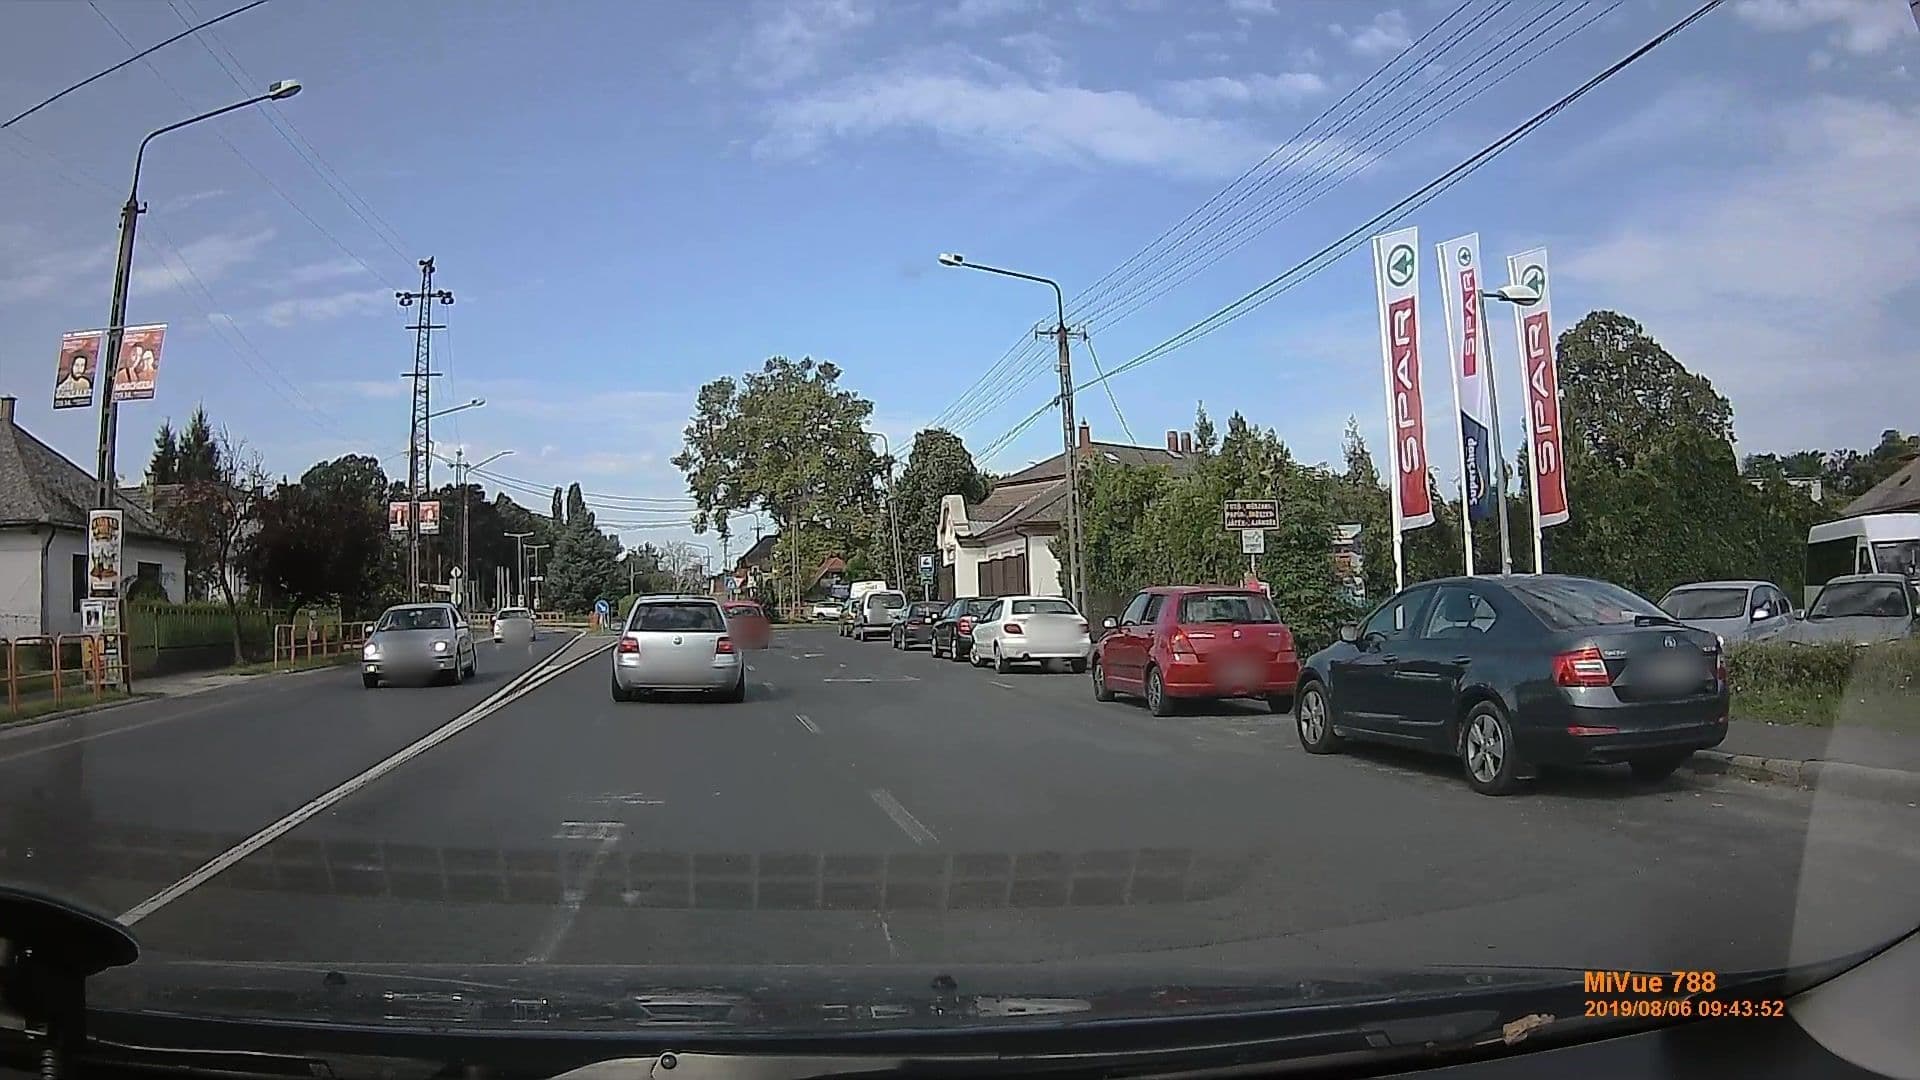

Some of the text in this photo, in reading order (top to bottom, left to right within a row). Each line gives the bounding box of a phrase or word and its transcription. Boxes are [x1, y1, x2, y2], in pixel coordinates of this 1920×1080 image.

[1394, 305, 1420, 475] SPAR
[1462, 271, 1476, 357] SPAR
[1528, 321, 1556, 475] SPAR
